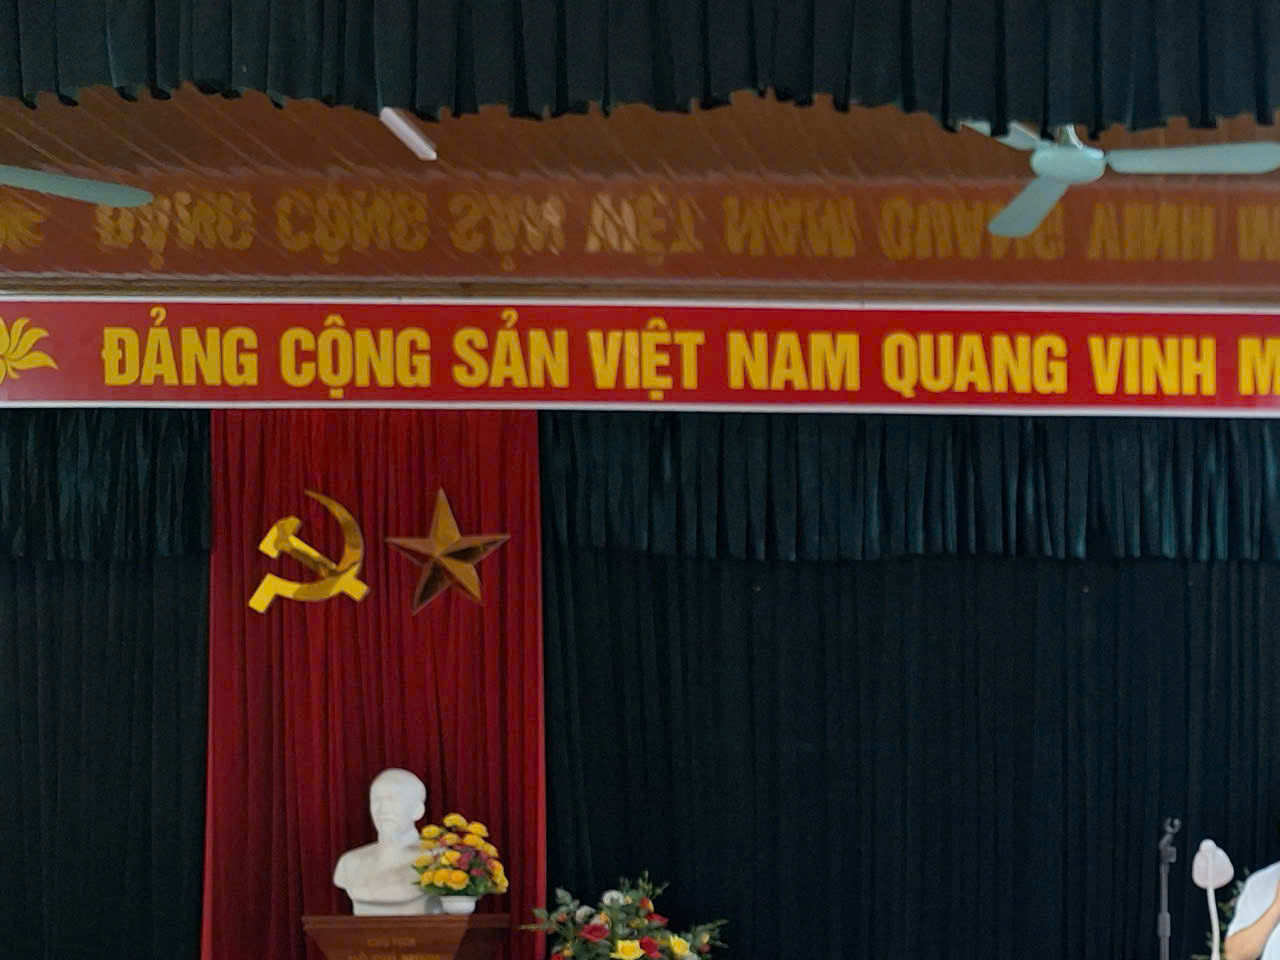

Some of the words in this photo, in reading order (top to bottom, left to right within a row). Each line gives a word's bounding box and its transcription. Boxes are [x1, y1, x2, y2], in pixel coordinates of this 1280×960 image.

[102, 306, 258, 386] ĐẢNG
[279, 315, 430, 400] CỘNG
[452, 309, 568, 389] SẢN
[588, 319, 705, 400] VIỆT
[728, 333, 859, 391] NAM
[881, 333, 1067, 399] QUANG
[1089, 337, 1216, 396] VINH
